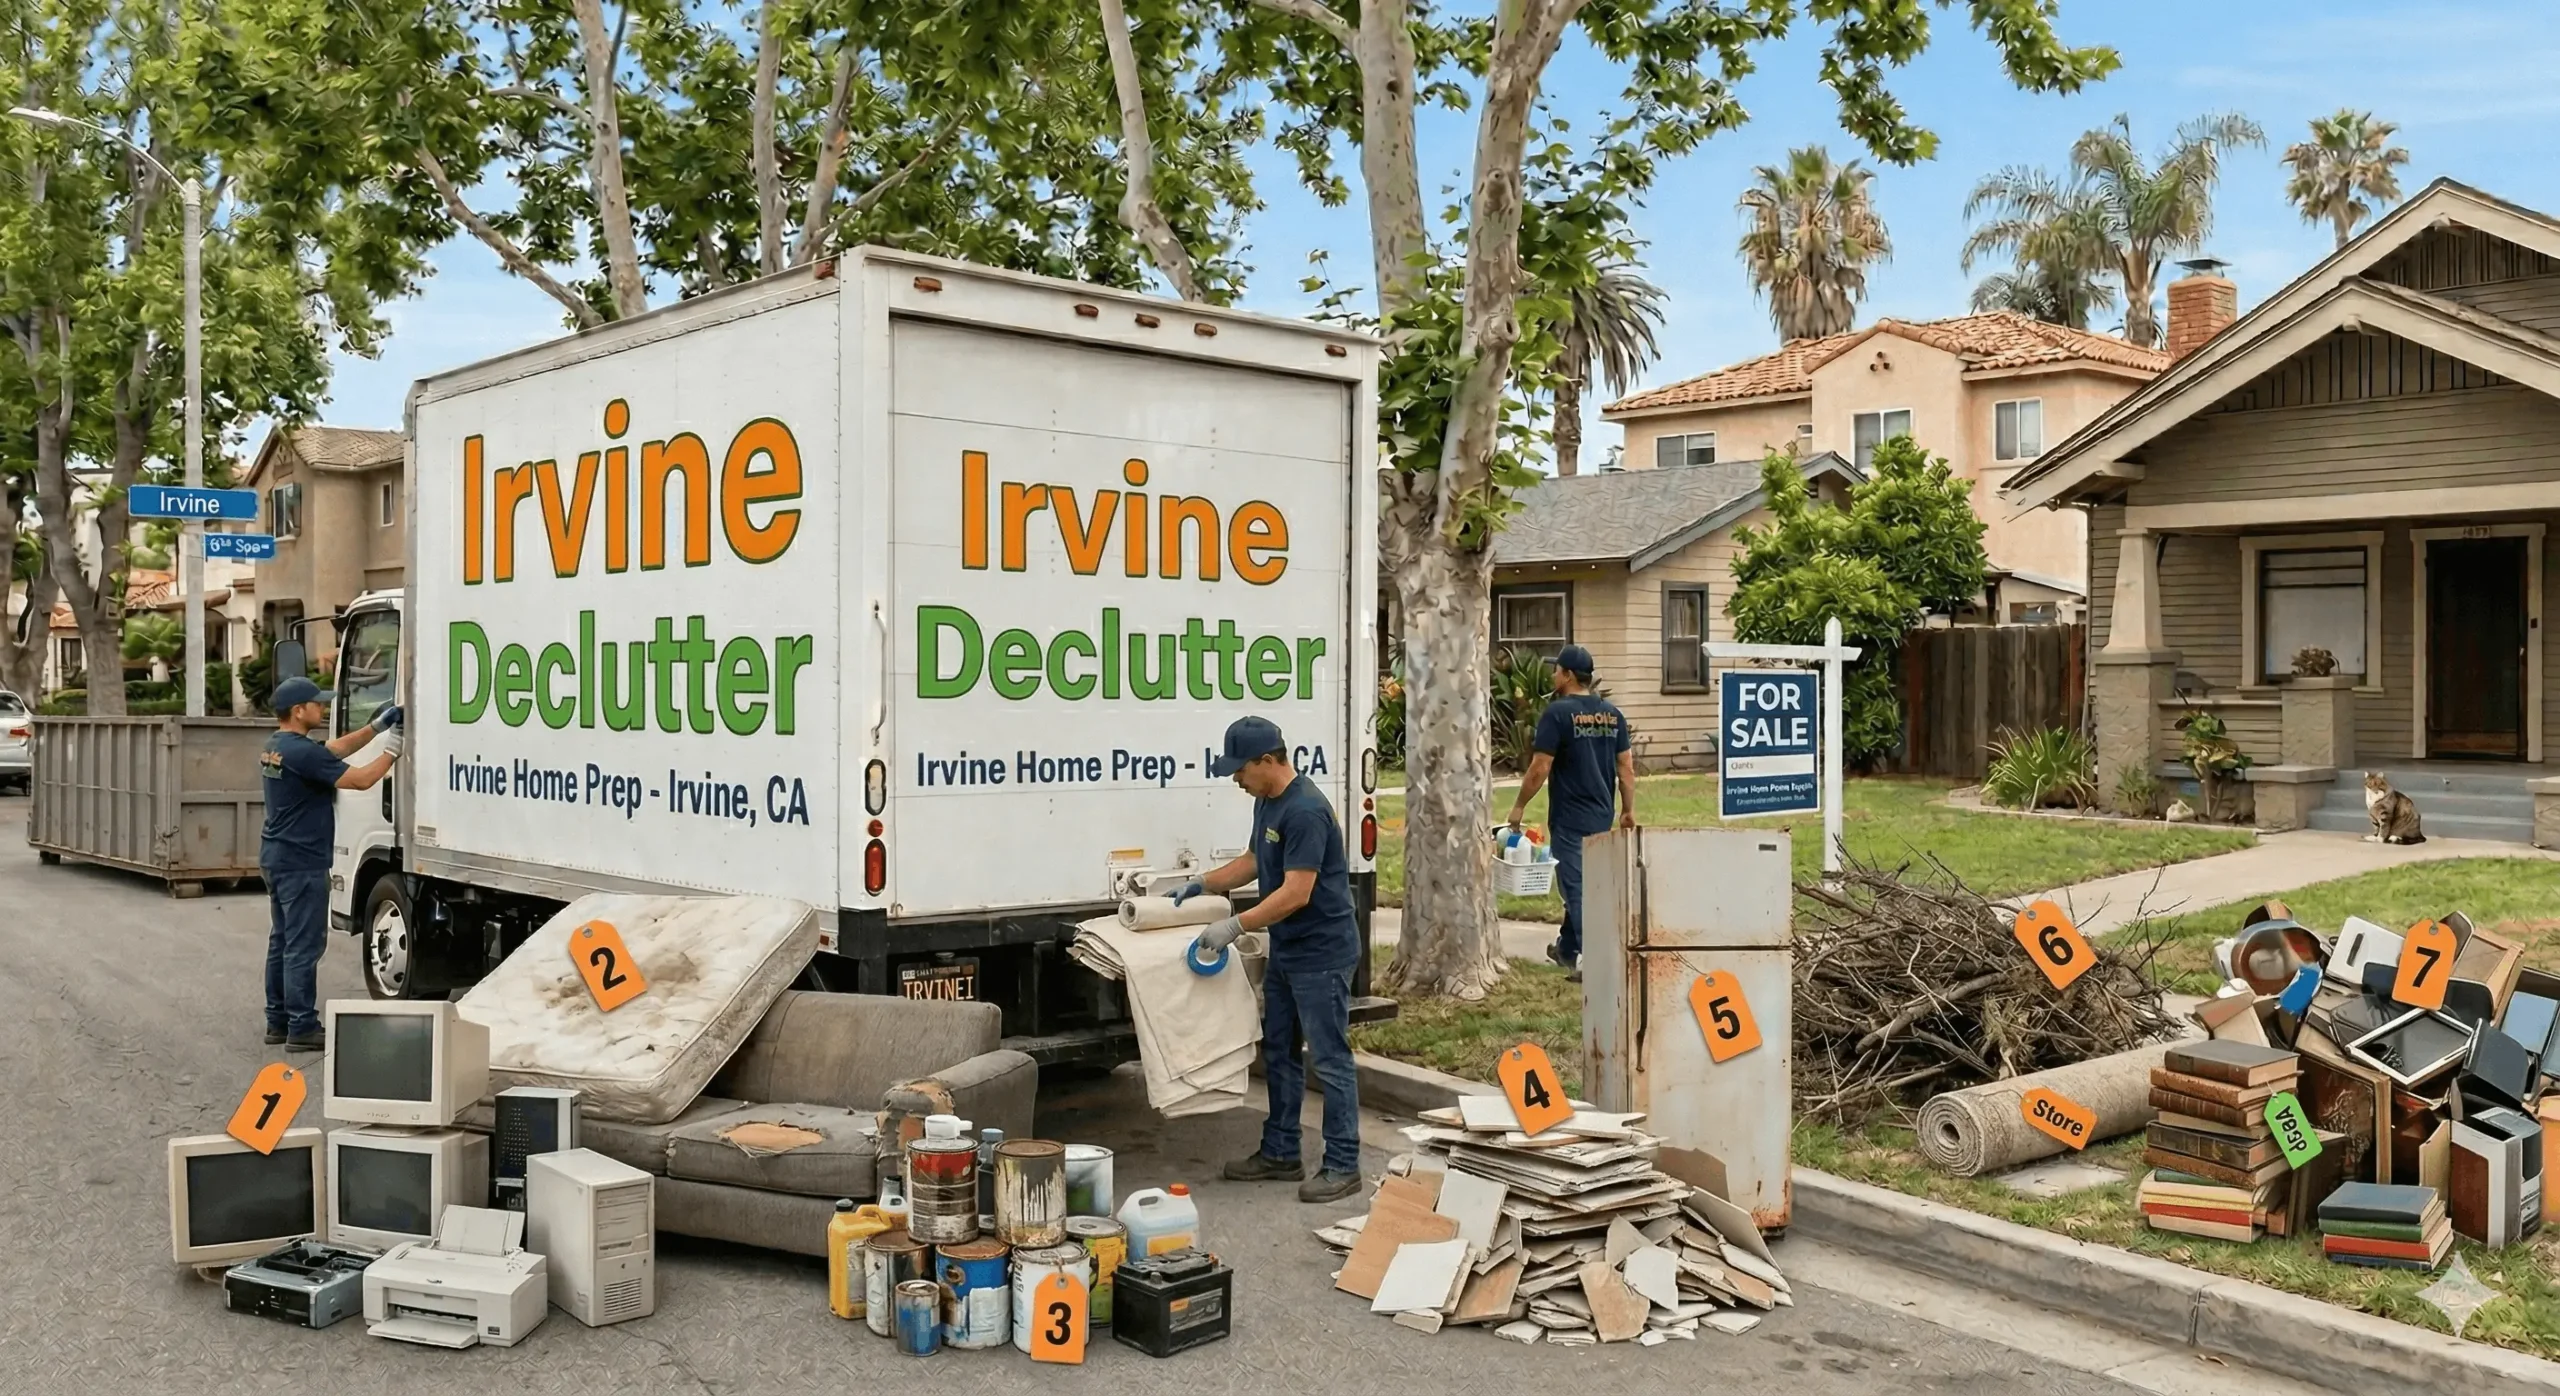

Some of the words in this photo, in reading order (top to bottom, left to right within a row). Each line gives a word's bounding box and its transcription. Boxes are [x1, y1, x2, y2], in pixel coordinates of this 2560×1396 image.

[160, 491, 220, 514] Irvine
[463, 397, 803, 586] Irvine
[961, 449, 1289, 586] Irvine
[449, 609, 813, 736] Declutter
[917, 605, 1327, 702] Declutter
[1738, 682, 1801, 711] FOR
[1730, 717, 1809, 748] SALE
[917, 750, 1006, 787] Irvine
[1016, 750, 1102, 784] Home
[1112, 749, 1176, 789] Prep
[1293, 745, 1328, 776] CA
[449, 754, 507, 796] Irvine
[514, 758, 578, 804] Home
[585, 763, 642, 820] Prep
[669, 768, 756, 828] Irvine,
[766, 774, 810, 826] CA
[2038, 925, 2074, 966] 6
[2412, 946, 2441, 988] 7
[590, 947, 627, 991] 2
[1708, 996, 1741, 1040] 5
[1524, 1069, 1551, 1109] 4
[255, 1092, 281, 1131] 1
[2033, 1099, 2084, 1137] Store
[1045, 1301, 1072, 1346] 3
